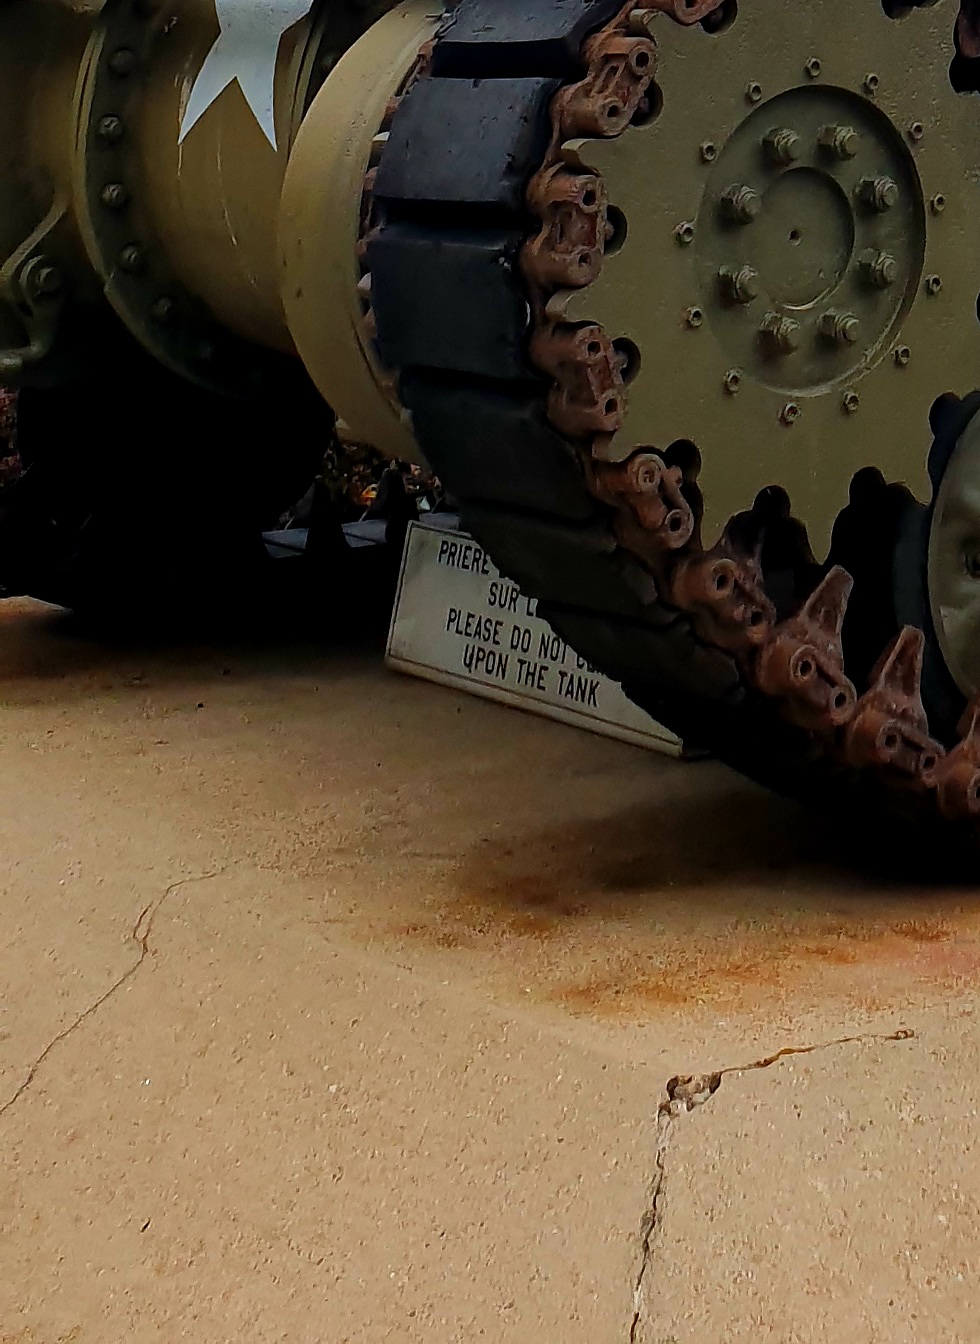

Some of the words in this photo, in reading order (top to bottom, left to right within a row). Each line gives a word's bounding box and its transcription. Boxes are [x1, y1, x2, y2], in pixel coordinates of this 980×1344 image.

[438, 540, 490, 575] PRIERE
[488, 582, 520, 613] SUR
[446, 607, 504, 646] PLEASE
[511, 625, 532, 653] DO
[463, 644, 509, 680] UPON
[517, 658, 549, 691] THE
[558, 670, 600, 707] TANK
